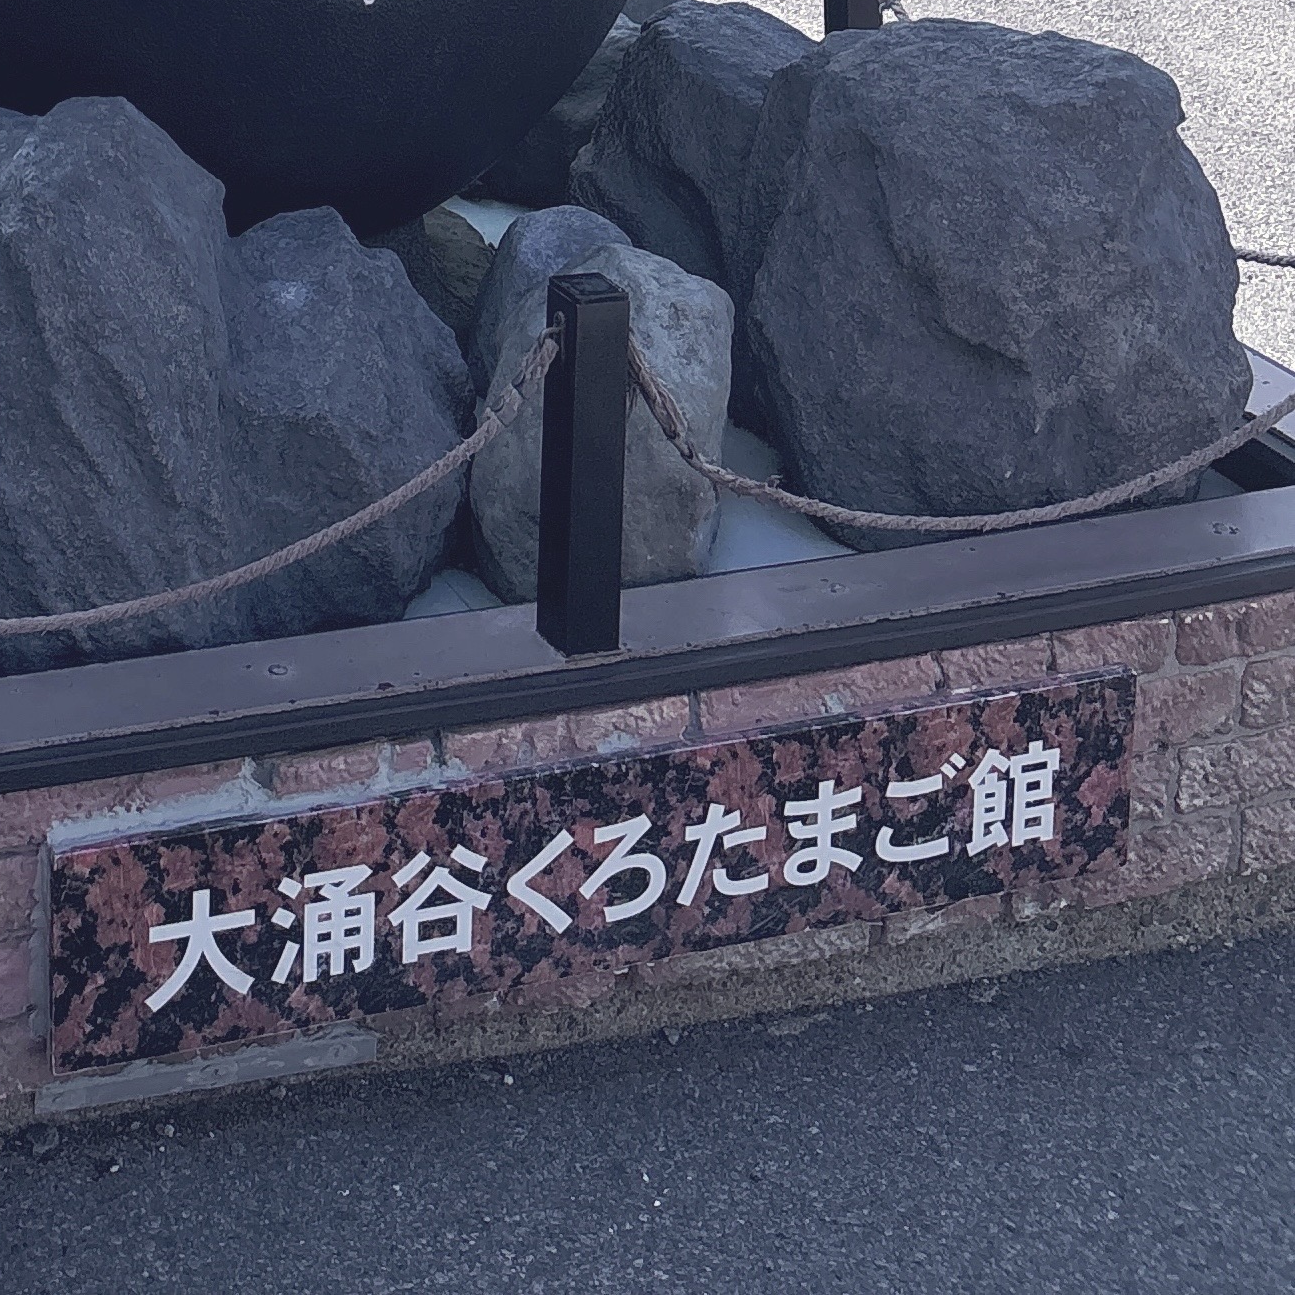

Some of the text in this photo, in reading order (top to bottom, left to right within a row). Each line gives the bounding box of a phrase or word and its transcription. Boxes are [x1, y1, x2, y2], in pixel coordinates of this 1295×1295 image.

[145, 740, 1060, 1012] 大涌谷くろたまご館
